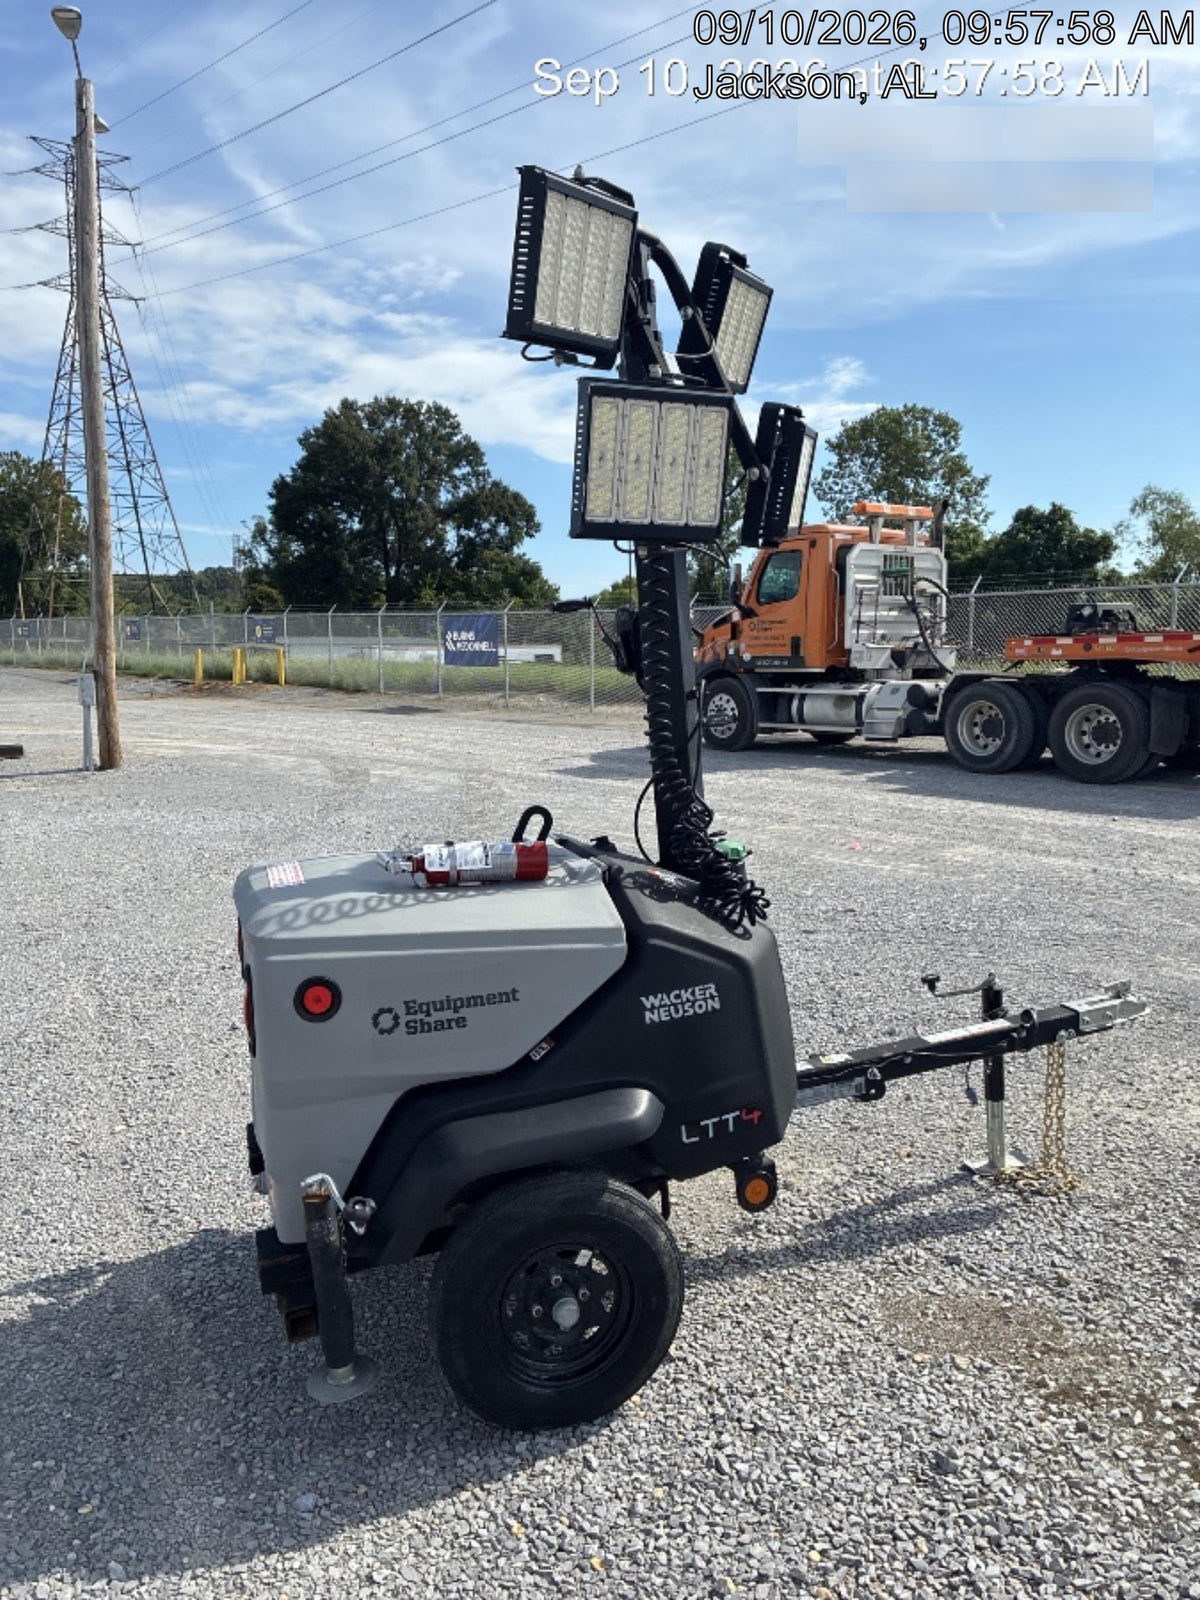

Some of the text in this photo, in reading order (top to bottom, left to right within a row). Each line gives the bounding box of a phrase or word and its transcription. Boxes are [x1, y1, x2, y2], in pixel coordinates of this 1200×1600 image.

[403, 987, 520, 1017] Equipment
[640, 982, 719, 1010] WACKER
[644, 996, 721, 1025] NEUSON
[404, 1015, 468, 1036] Share
